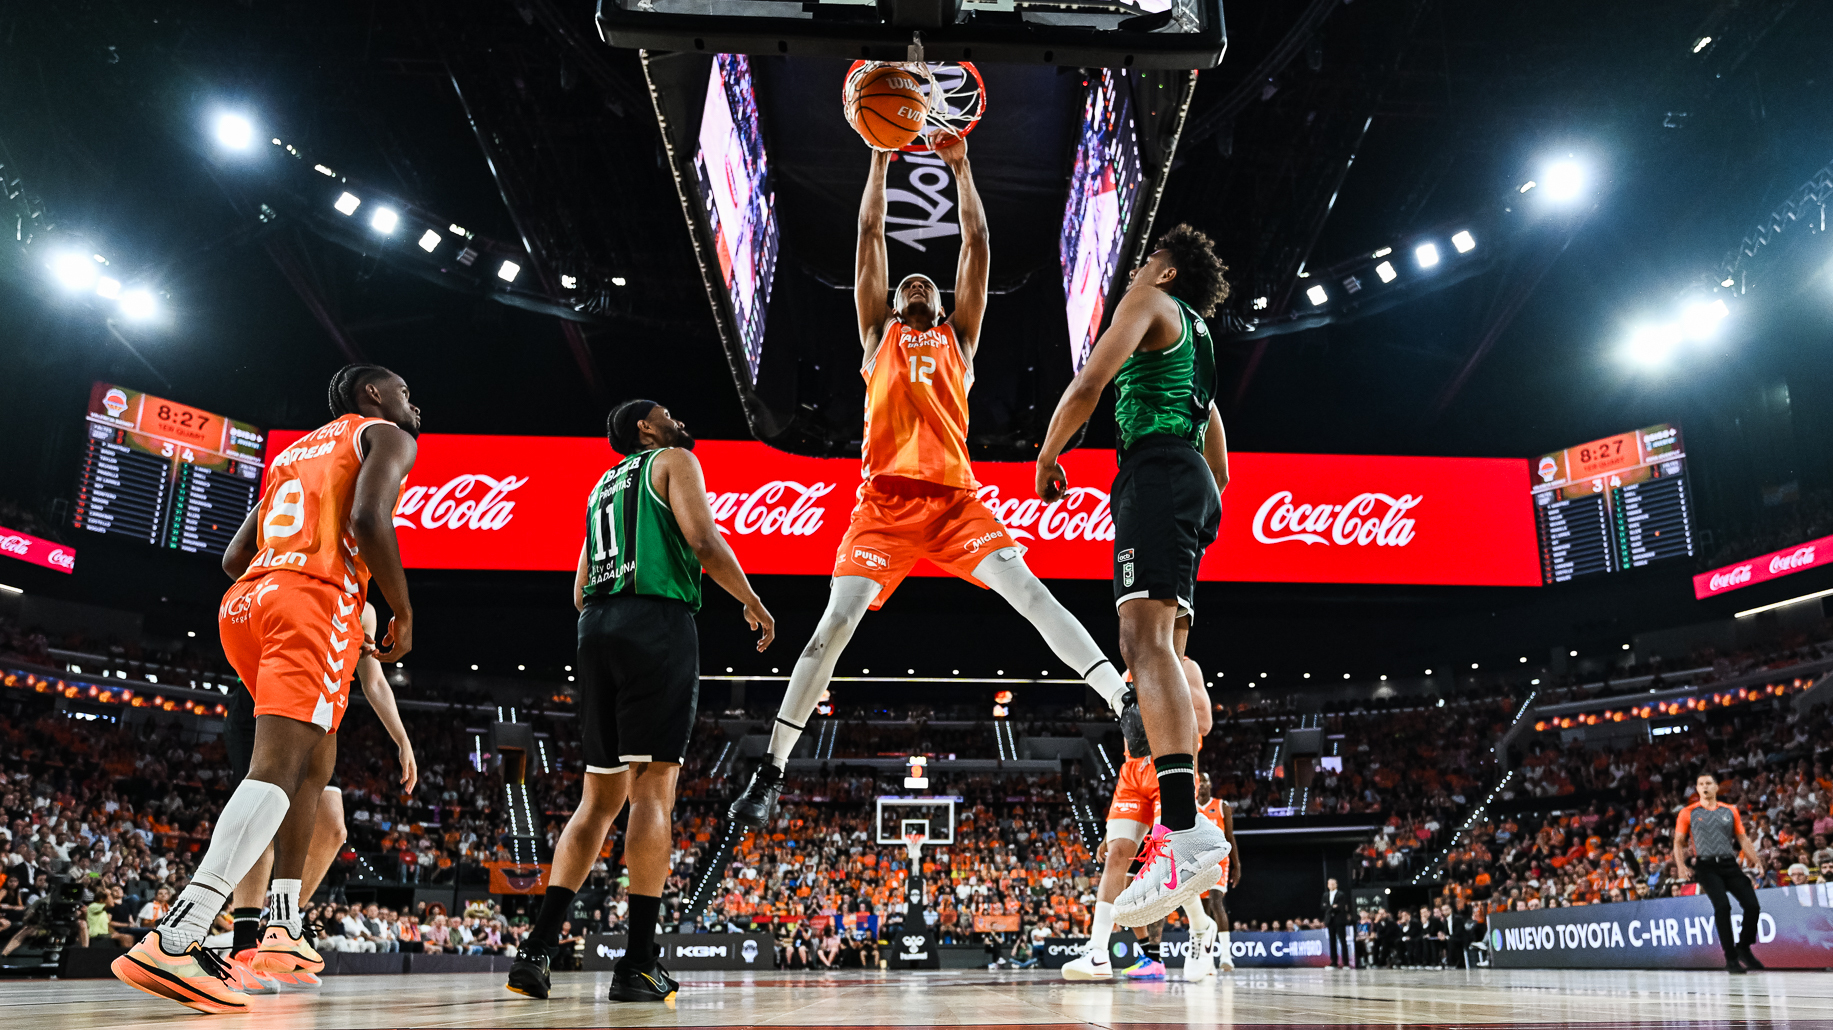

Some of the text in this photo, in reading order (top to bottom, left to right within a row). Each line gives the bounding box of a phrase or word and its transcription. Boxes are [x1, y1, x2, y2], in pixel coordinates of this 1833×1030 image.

[908, 355, 937, 386] 12
[158, 405, 210, 431] 8:27
[161, 442, 175, 457] 3
[181, 448, 195, 463] 4
[271, 440, 336, 473] AMESA
[1580, 440, 1623, 463] 8:27
[1592, 479, 1604, 493] 3
[1610, 475, 1622, 488] 4
[263, 477, 305, 541] 8
[1252, 490, 1423, 546] Coca-Cola
[593, 503, 618, 562] 11
[963, 529, 1004, 553] Midea
[854, 549, 887, 567] PULEVA
[590, 560, 636, 586] BADALONA
[1504, 926, 1555, 951] NUEVO
[1555, 921, 1625, 949] TOYOTA
[1628, 918, 1682, 948] C-HR
[676, 945, 728, 958] KGM
[1132, 942, 1190, 958] NEVO
